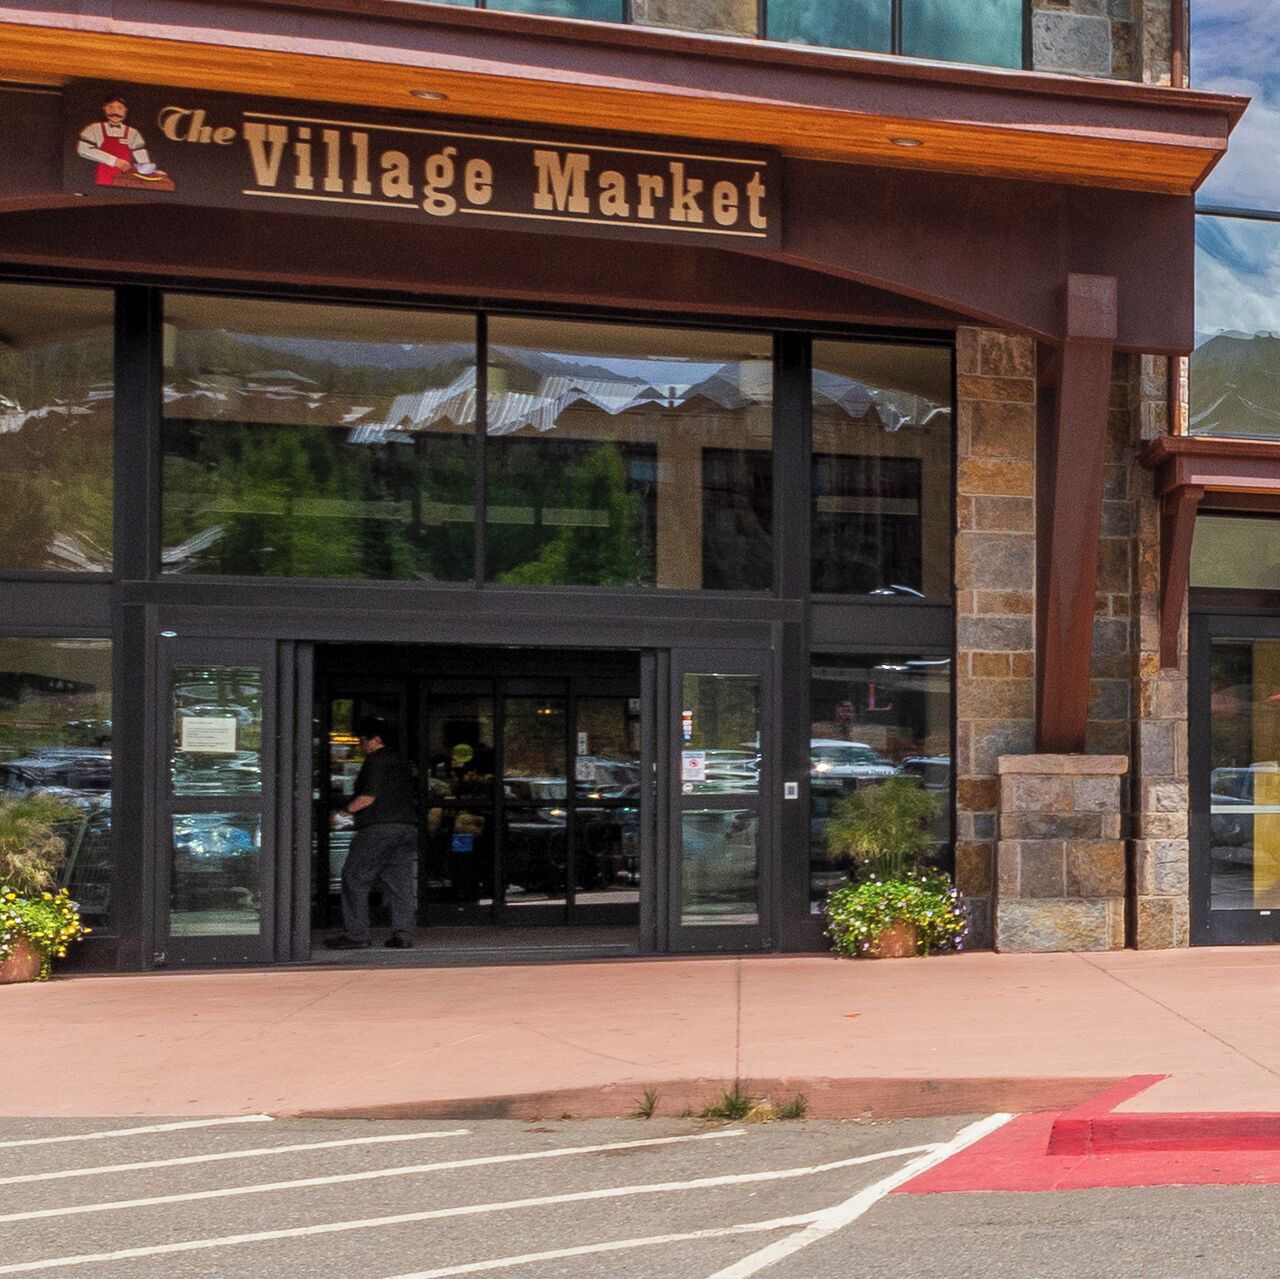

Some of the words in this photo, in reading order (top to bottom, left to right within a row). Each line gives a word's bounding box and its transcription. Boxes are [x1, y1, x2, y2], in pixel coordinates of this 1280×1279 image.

[157, 106, 236, 147] The
[243, 122, 494, 216] Village
[533, 148, 767, 229] Market
